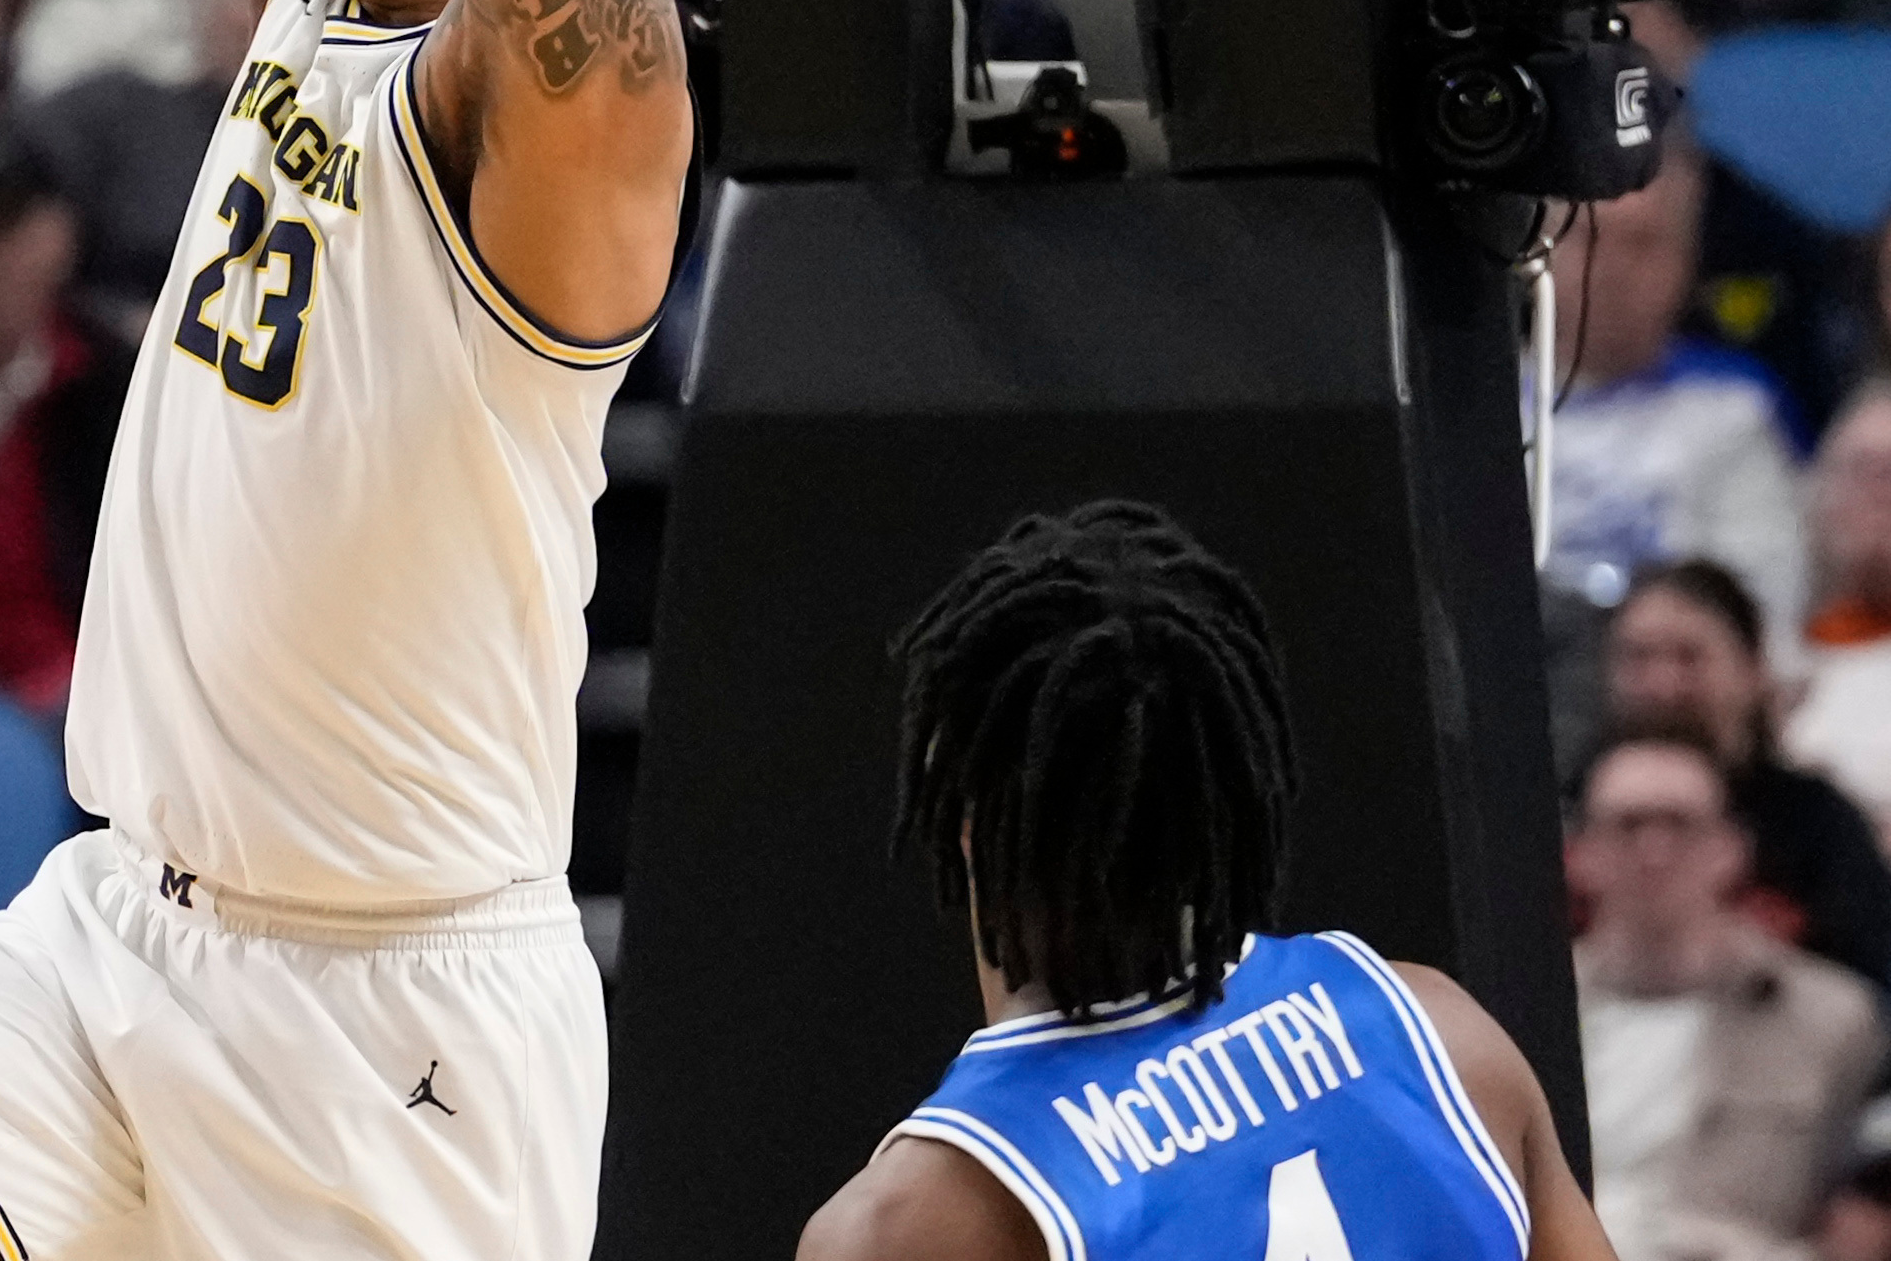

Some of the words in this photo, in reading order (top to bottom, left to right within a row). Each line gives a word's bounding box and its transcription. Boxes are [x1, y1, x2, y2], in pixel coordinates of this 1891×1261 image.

[173, 171, 323, 413] 23
[159, 862, 198, 909] M
[1052, 981, 1364, 1187] McCOTTRY
